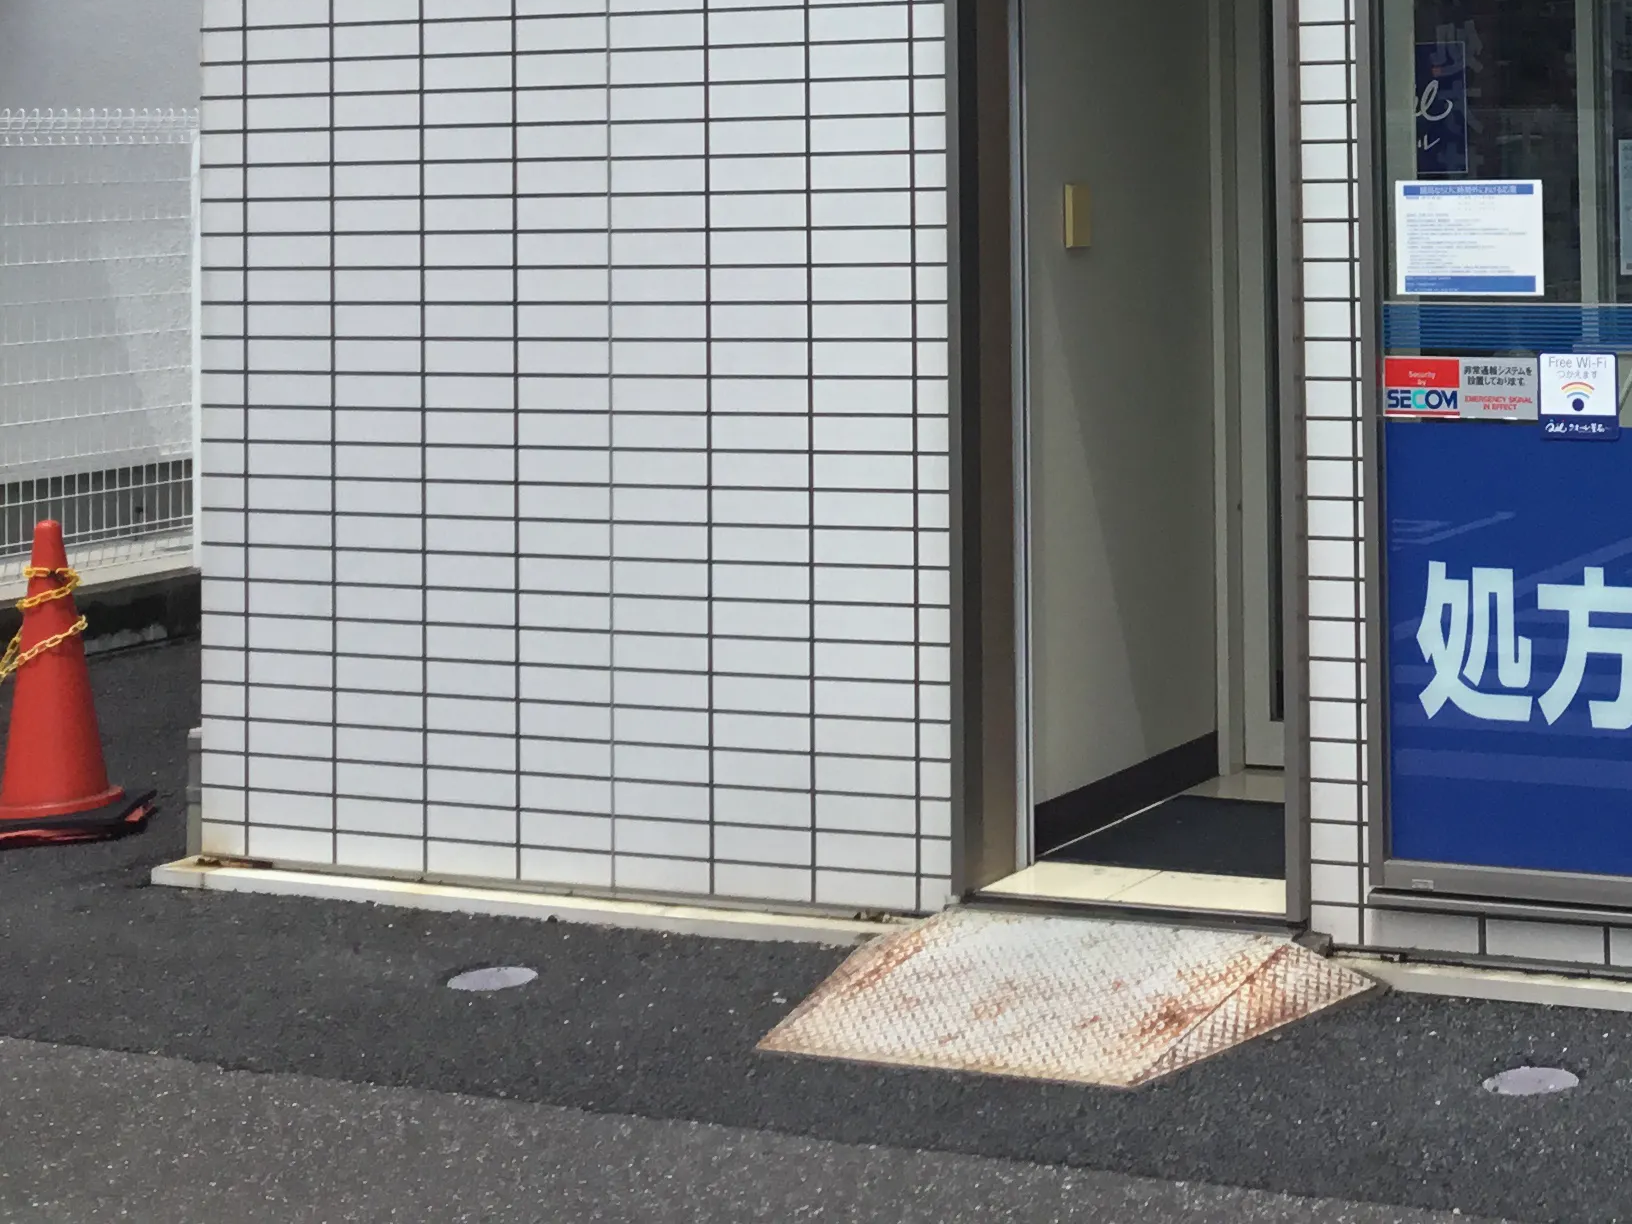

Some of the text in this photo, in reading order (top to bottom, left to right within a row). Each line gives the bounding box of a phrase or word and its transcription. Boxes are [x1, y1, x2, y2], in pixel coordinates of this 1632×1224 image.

[1548, 356, 1607, 368] Free Wi-Fi
[1408, 370, 1436, 380] Security
[1556, 370, 1598, 380] つかえます
[1417, 379, 1427, 387] by
[1387, 389, 1458, 409] SECOM
[1464, 395, 1533, 404] EMERGENCY SIGNAL
[1483, 403, 1518, 411] IN EFFECT
